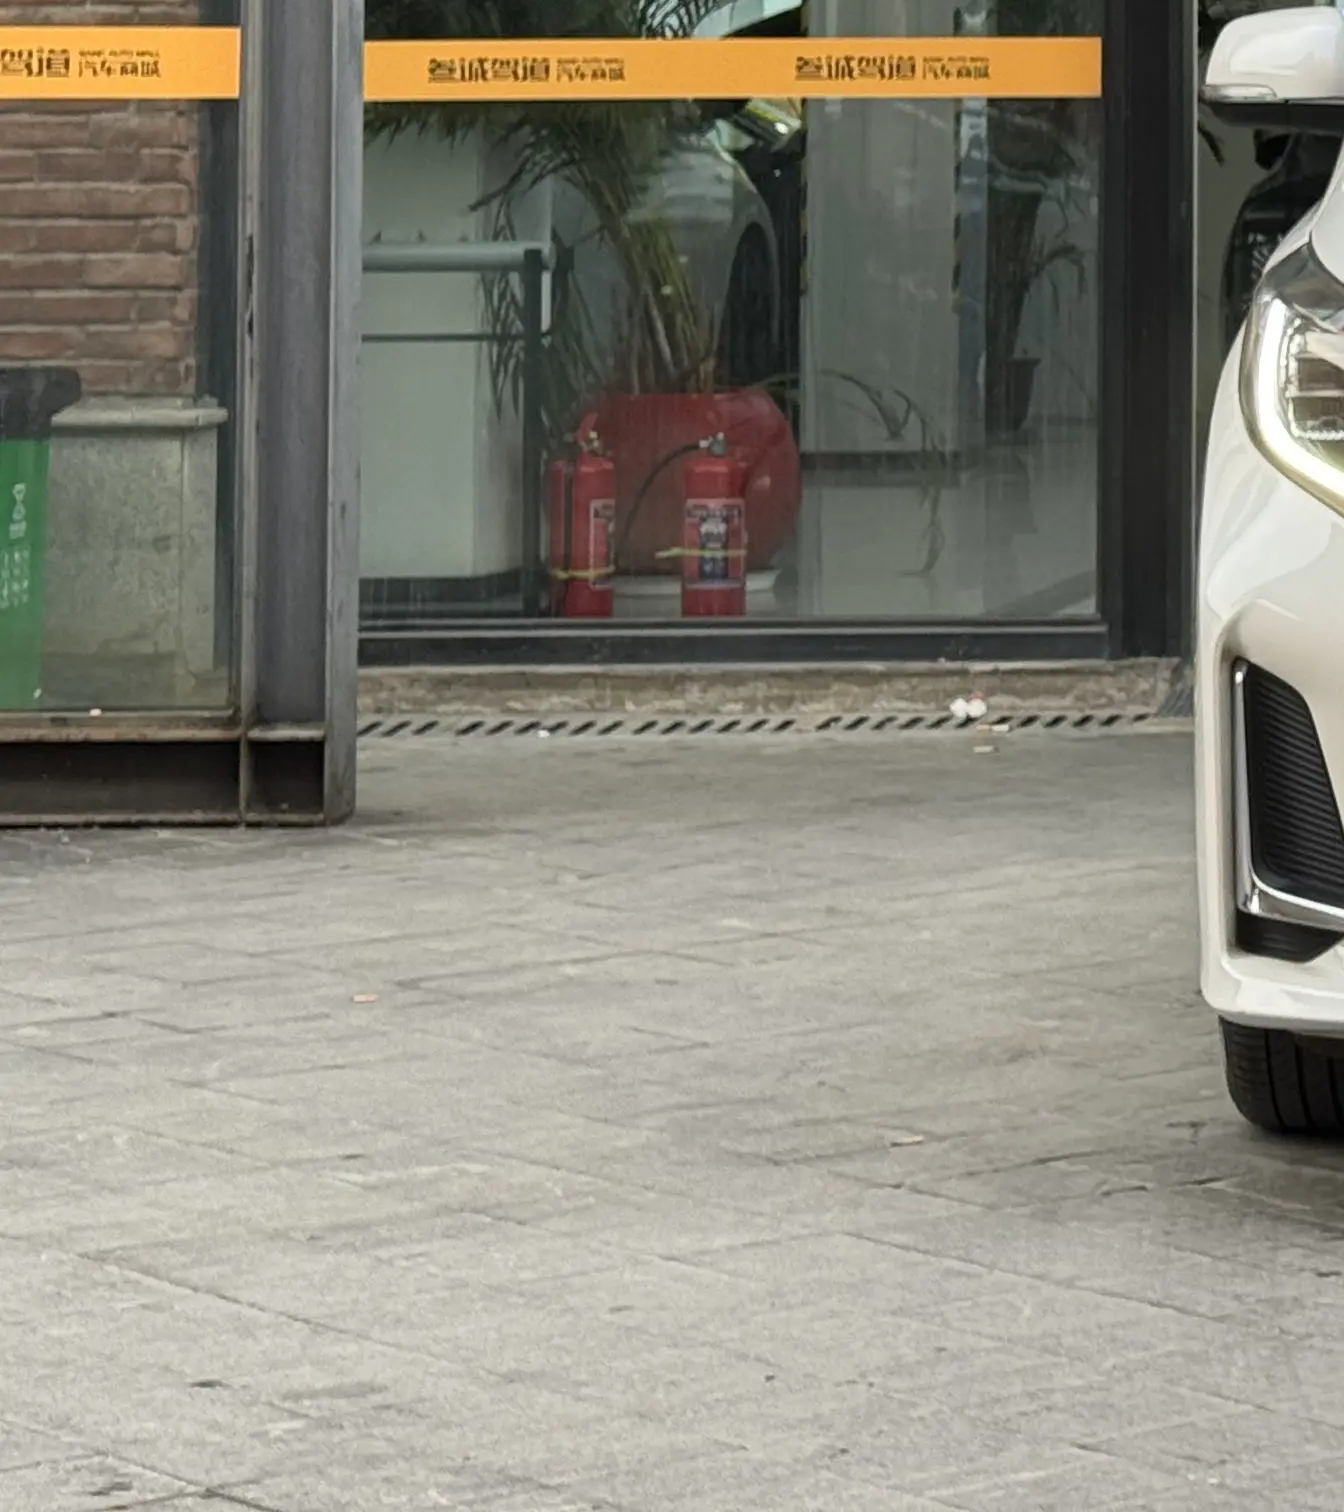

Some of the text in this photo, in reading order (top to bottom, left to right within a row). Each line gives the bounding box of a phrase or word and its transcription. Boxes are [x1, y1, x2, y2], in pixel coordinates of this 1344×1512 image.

[427, 56, 550, 82] 叁诚驾道
[794, 55, 916, 80] 叁诚驾道
